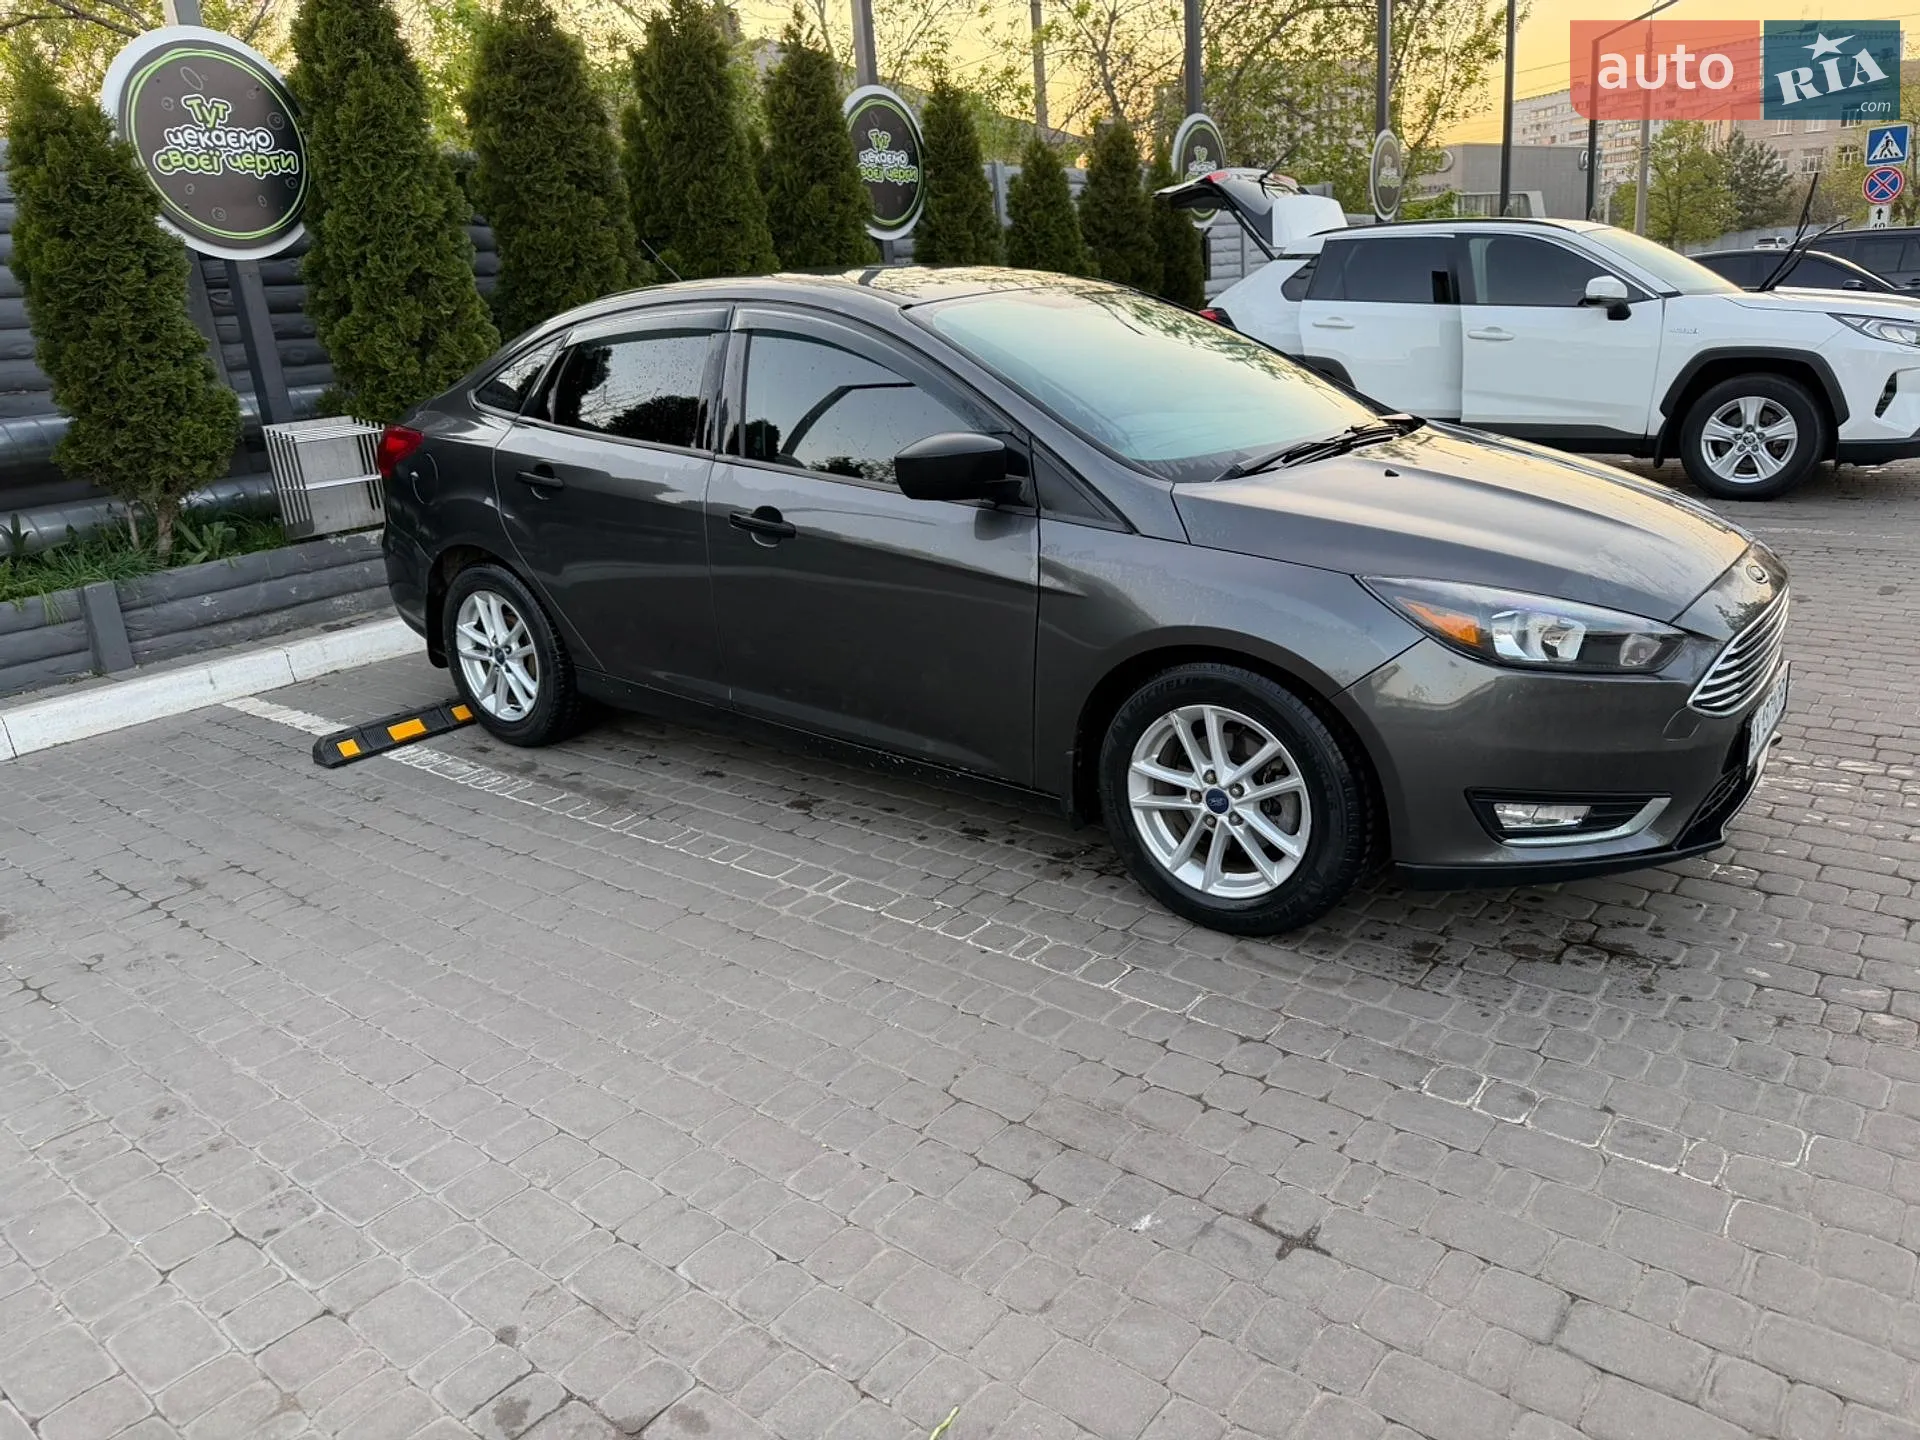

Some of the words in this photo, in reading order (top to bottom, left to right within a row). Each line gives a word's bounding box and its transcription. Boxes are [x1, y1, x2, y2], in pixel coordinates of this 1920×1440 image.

[184, 97, 229, 128] Тут
[167, 128, 271, 150] чекаємо
[156, 149, 221, 172] своєї
[227, 151, 296, 176] черги
